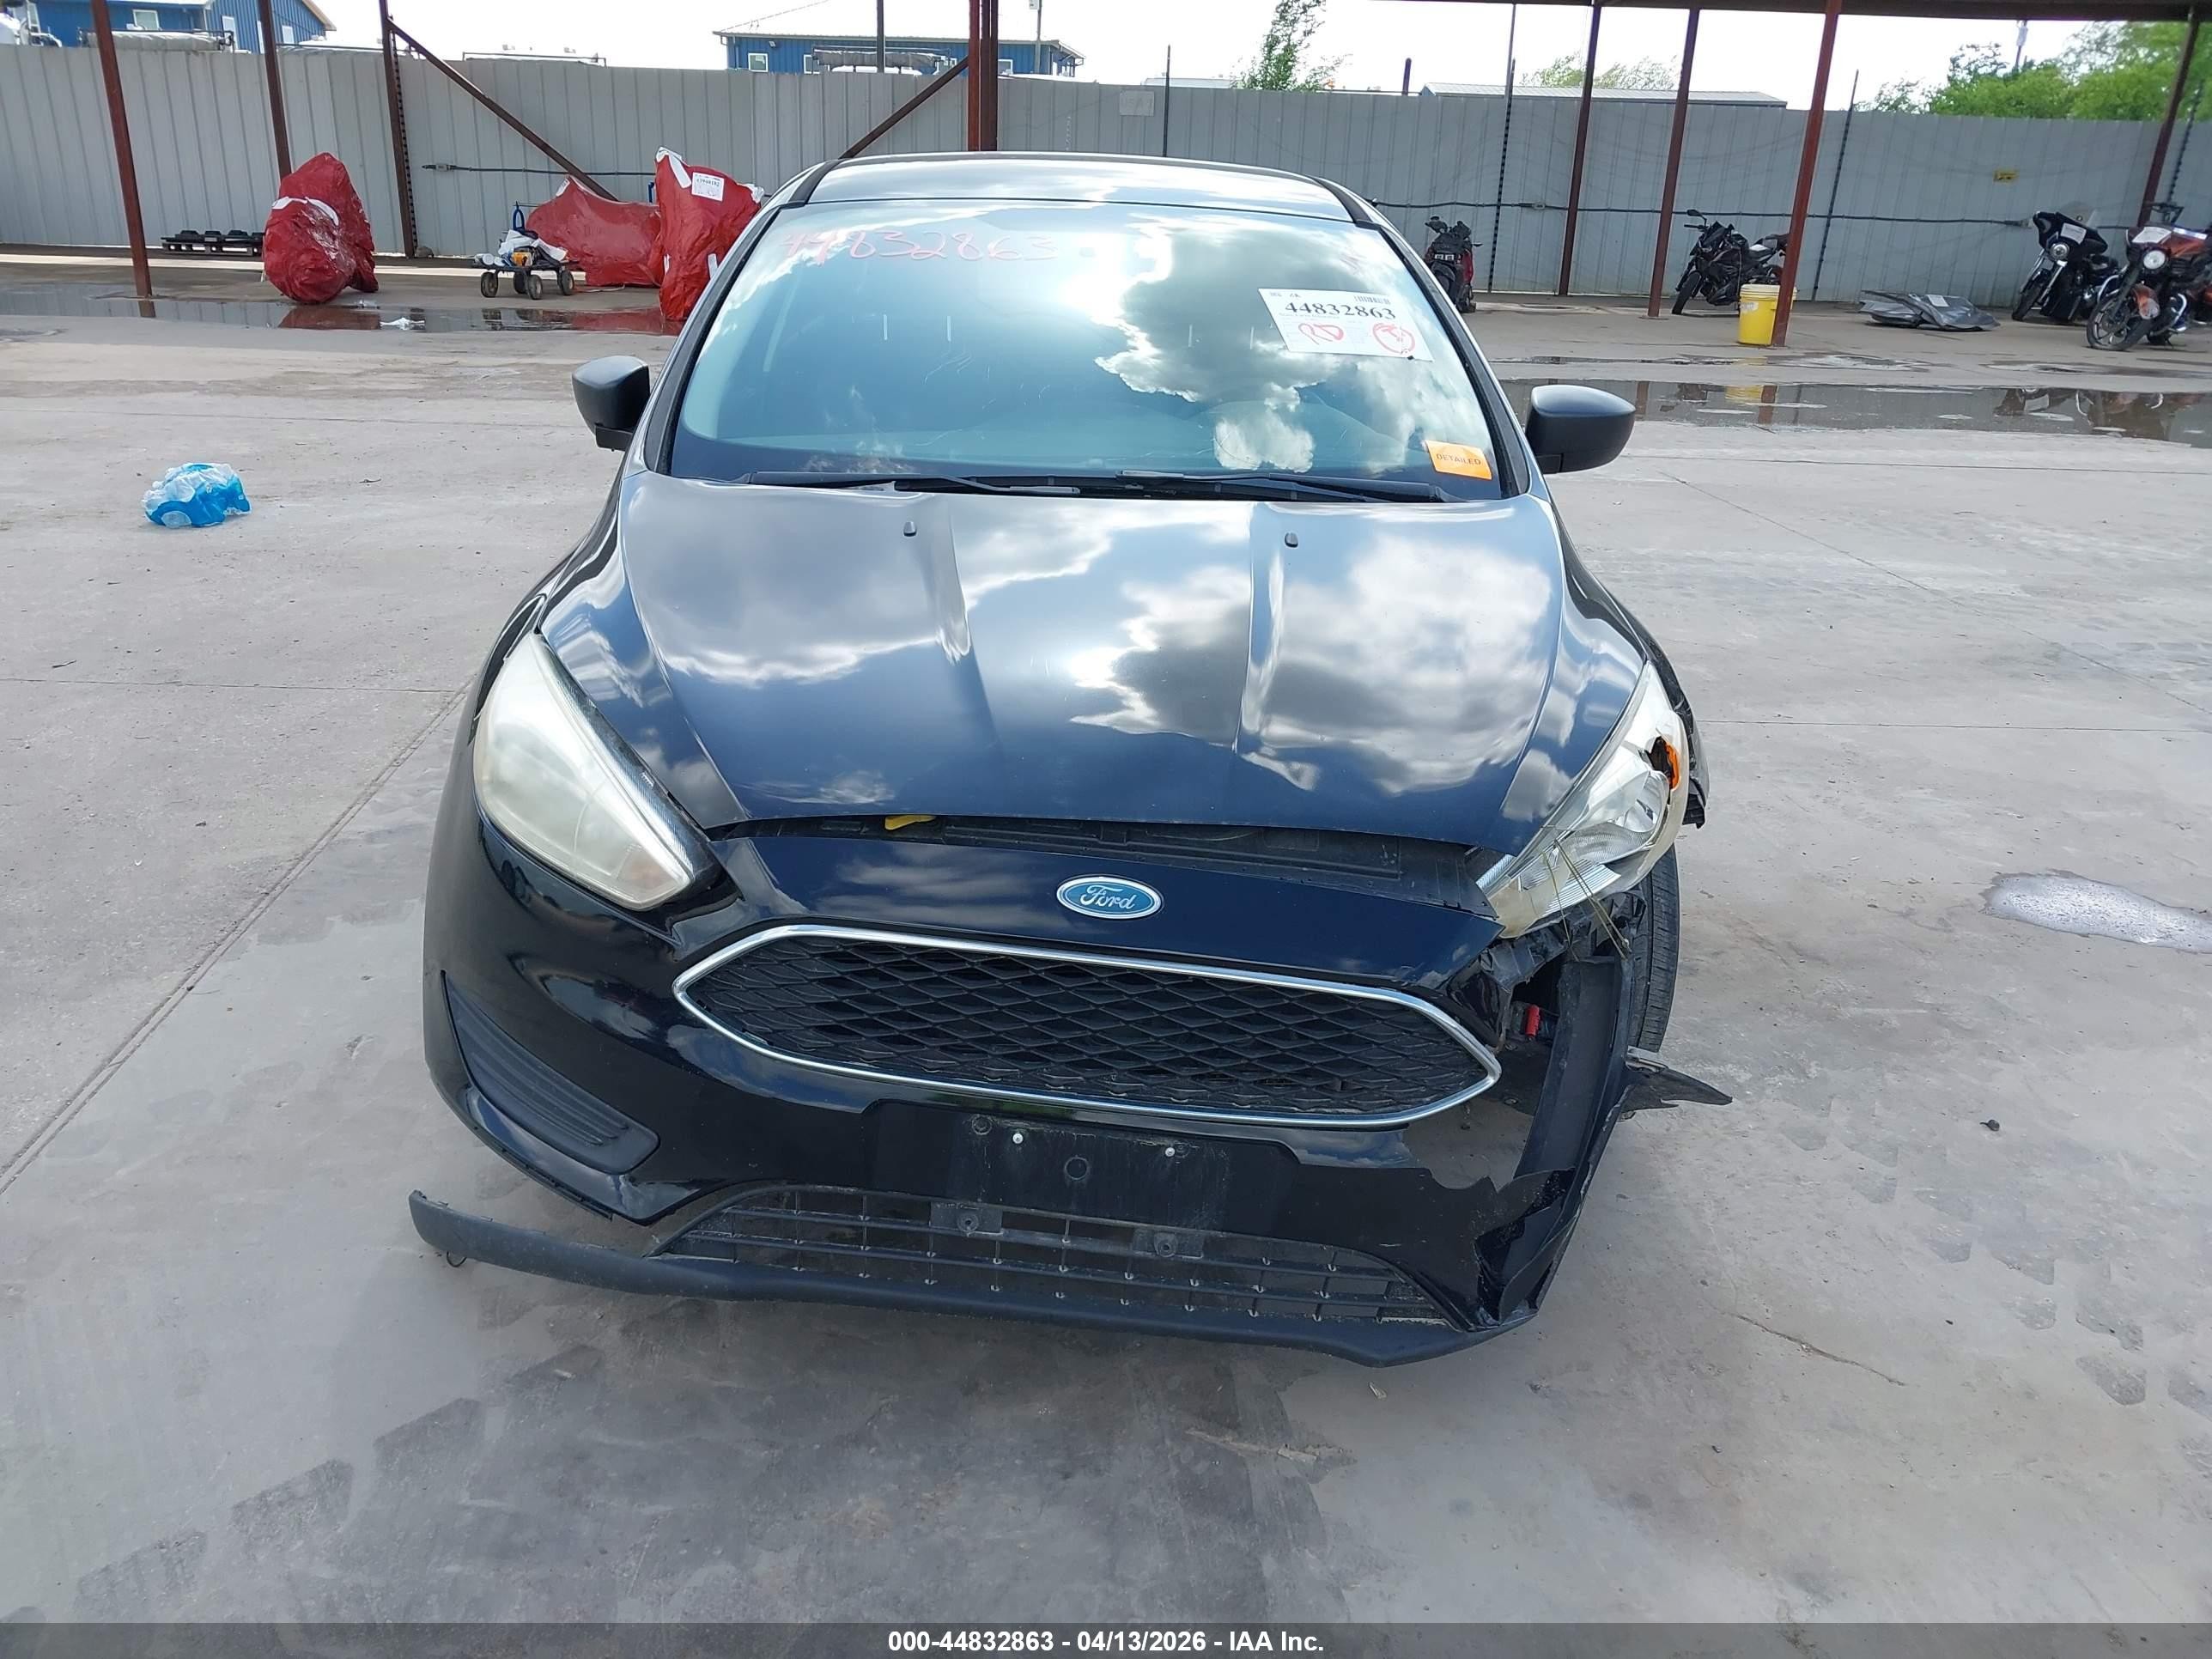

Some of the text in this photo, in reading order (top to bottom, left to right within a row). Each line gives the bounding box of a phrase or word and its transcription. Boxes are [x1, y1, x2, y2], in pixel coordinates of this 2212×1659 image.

[1285, 301, 1396, 319] 44832863
[1436, 453, 1481, 465] DETAILED
[1079, 884, 1137, 909] Ford
